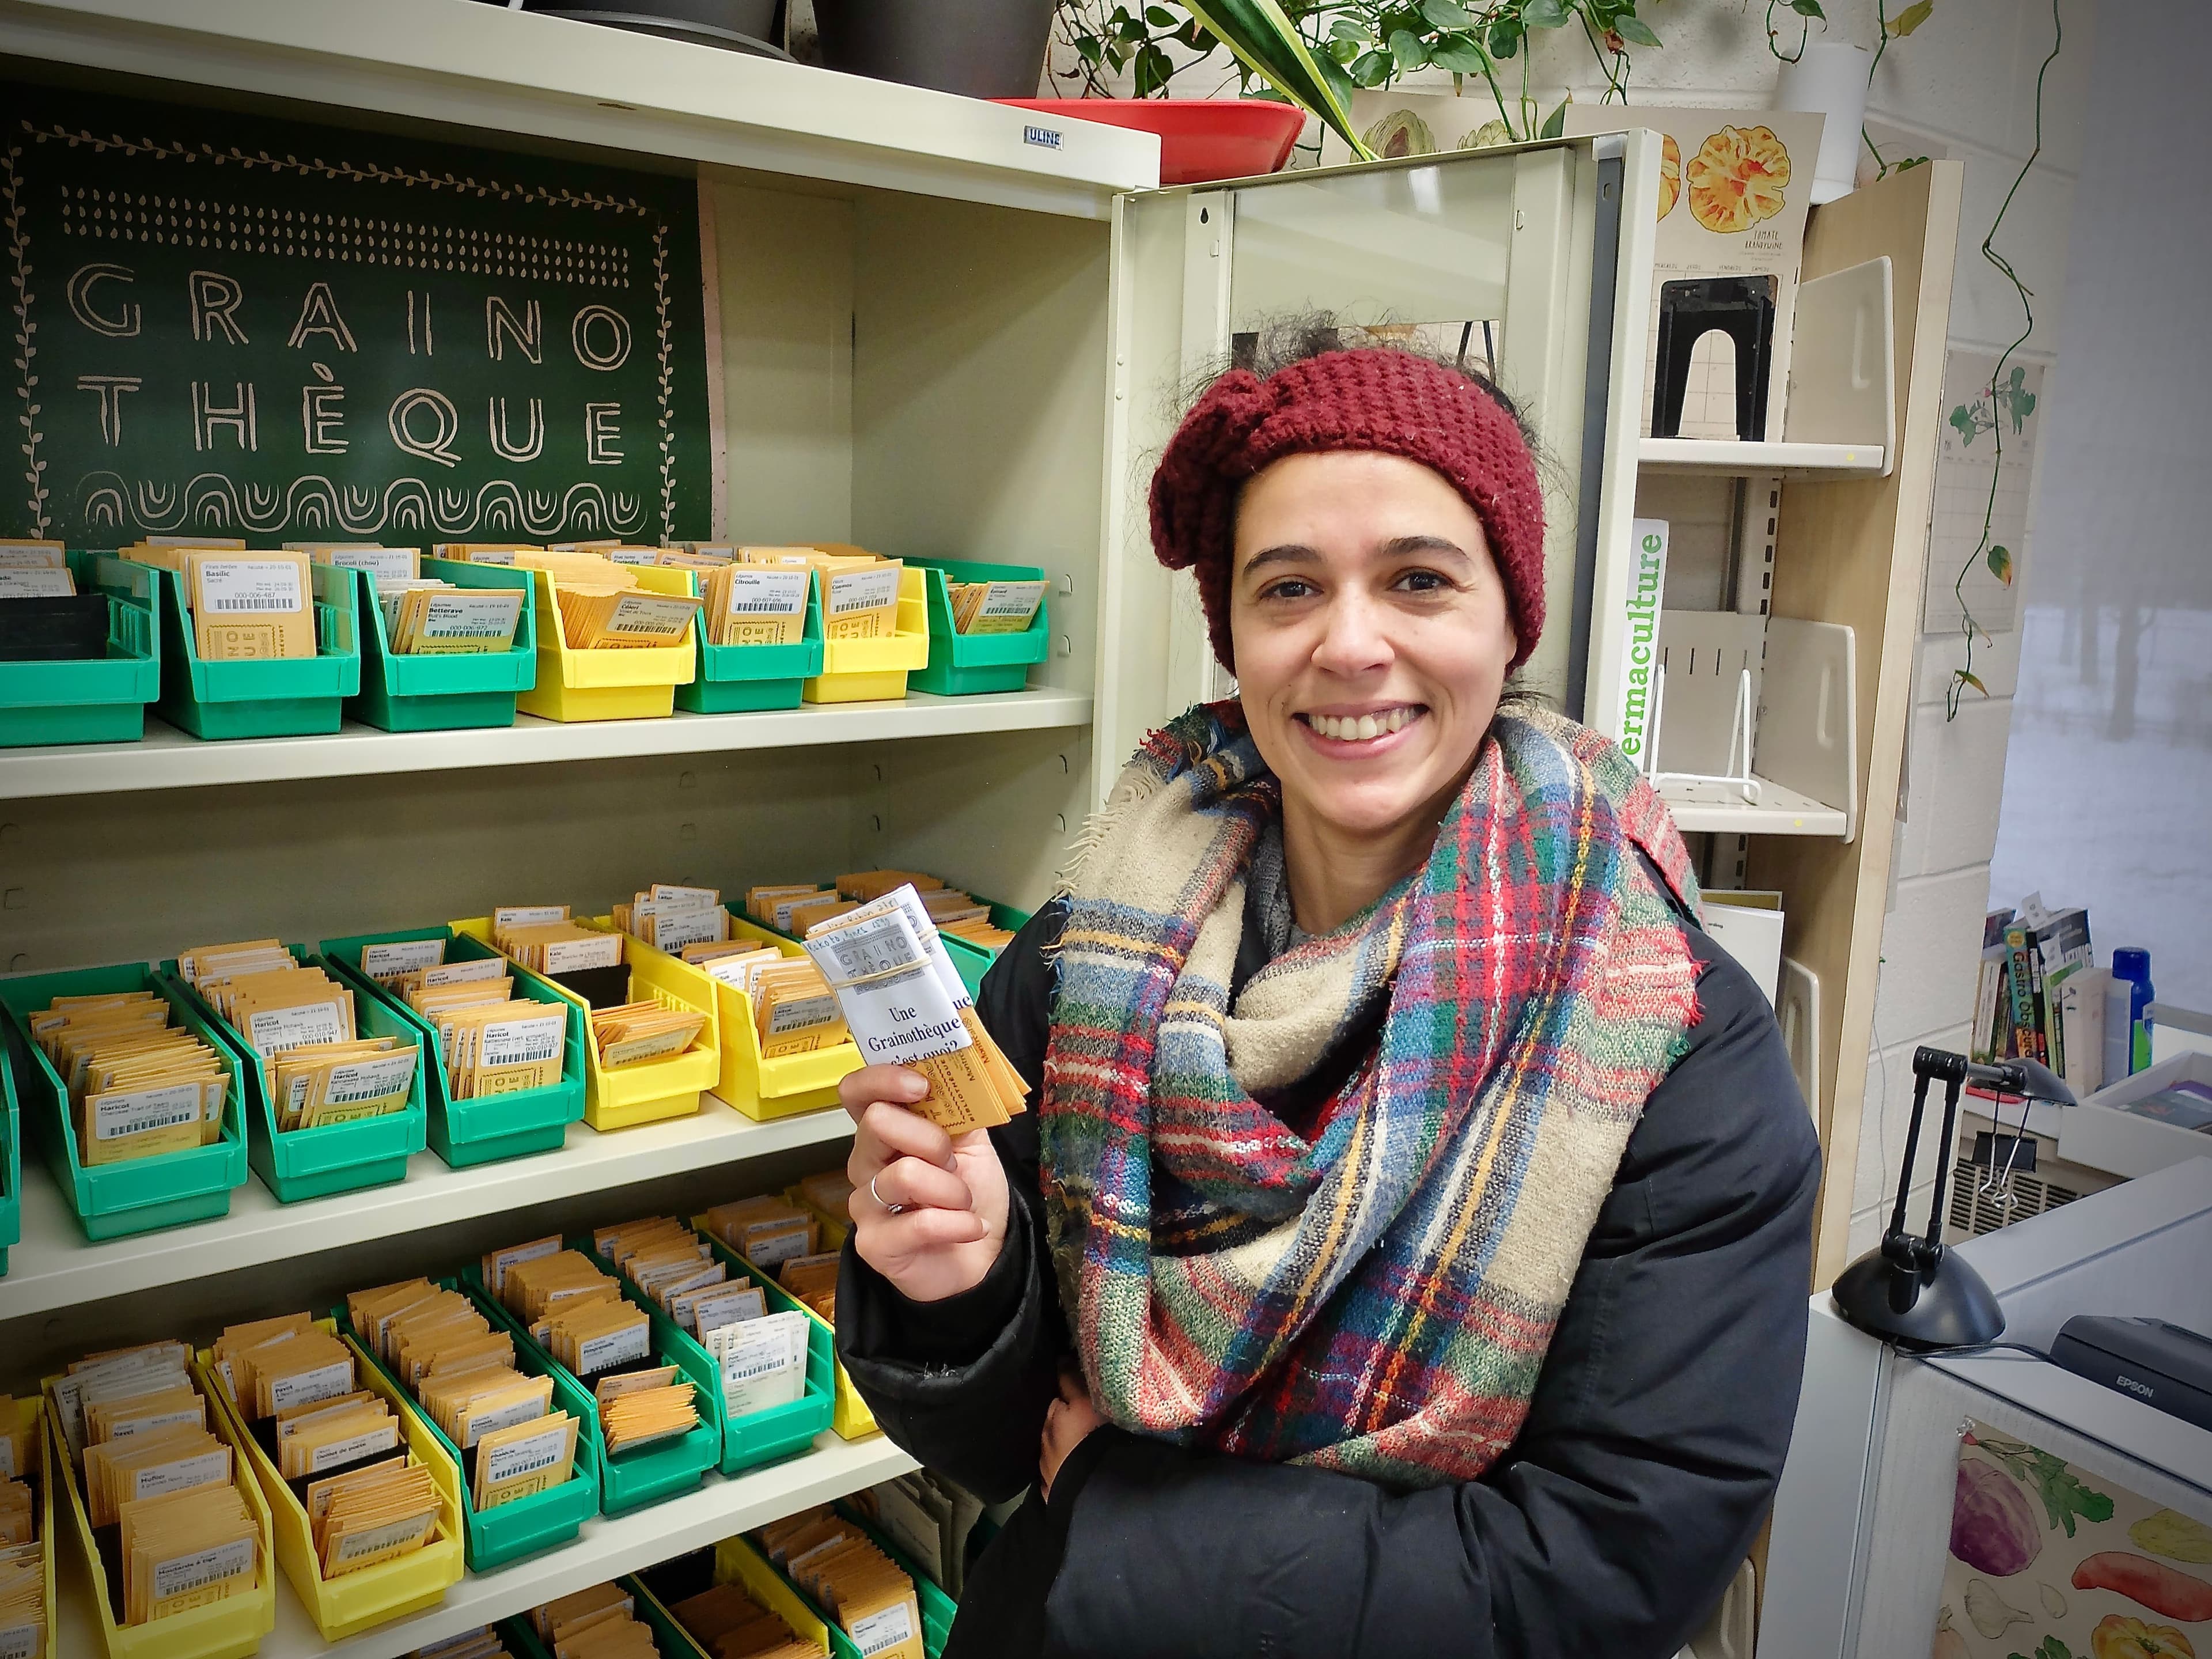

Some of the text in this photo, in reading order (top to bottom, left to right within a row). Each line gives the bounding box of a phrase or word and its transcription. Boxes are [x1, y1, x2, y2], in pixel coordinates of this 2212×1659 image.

[1031, 128, 1060, 145] ULINE
[1754, 230, 1778, 240] TOMATE
[66, 263, 633, 373] GRAINO
[77, 361, 623, 468] THÈQUE
[1621, 533, 1662, 756] ermaculture
[840, 936, 907, 965] GRAINO
[2013, 951, 2026, 997] Gastro
[255, 1020, 279, 1028] Haricot
[888, 1007, 917, 1022] Une
[868, 1017, 961, 1052] Grainothèque
[2116, 1374, 2154, 1399] EPSON
